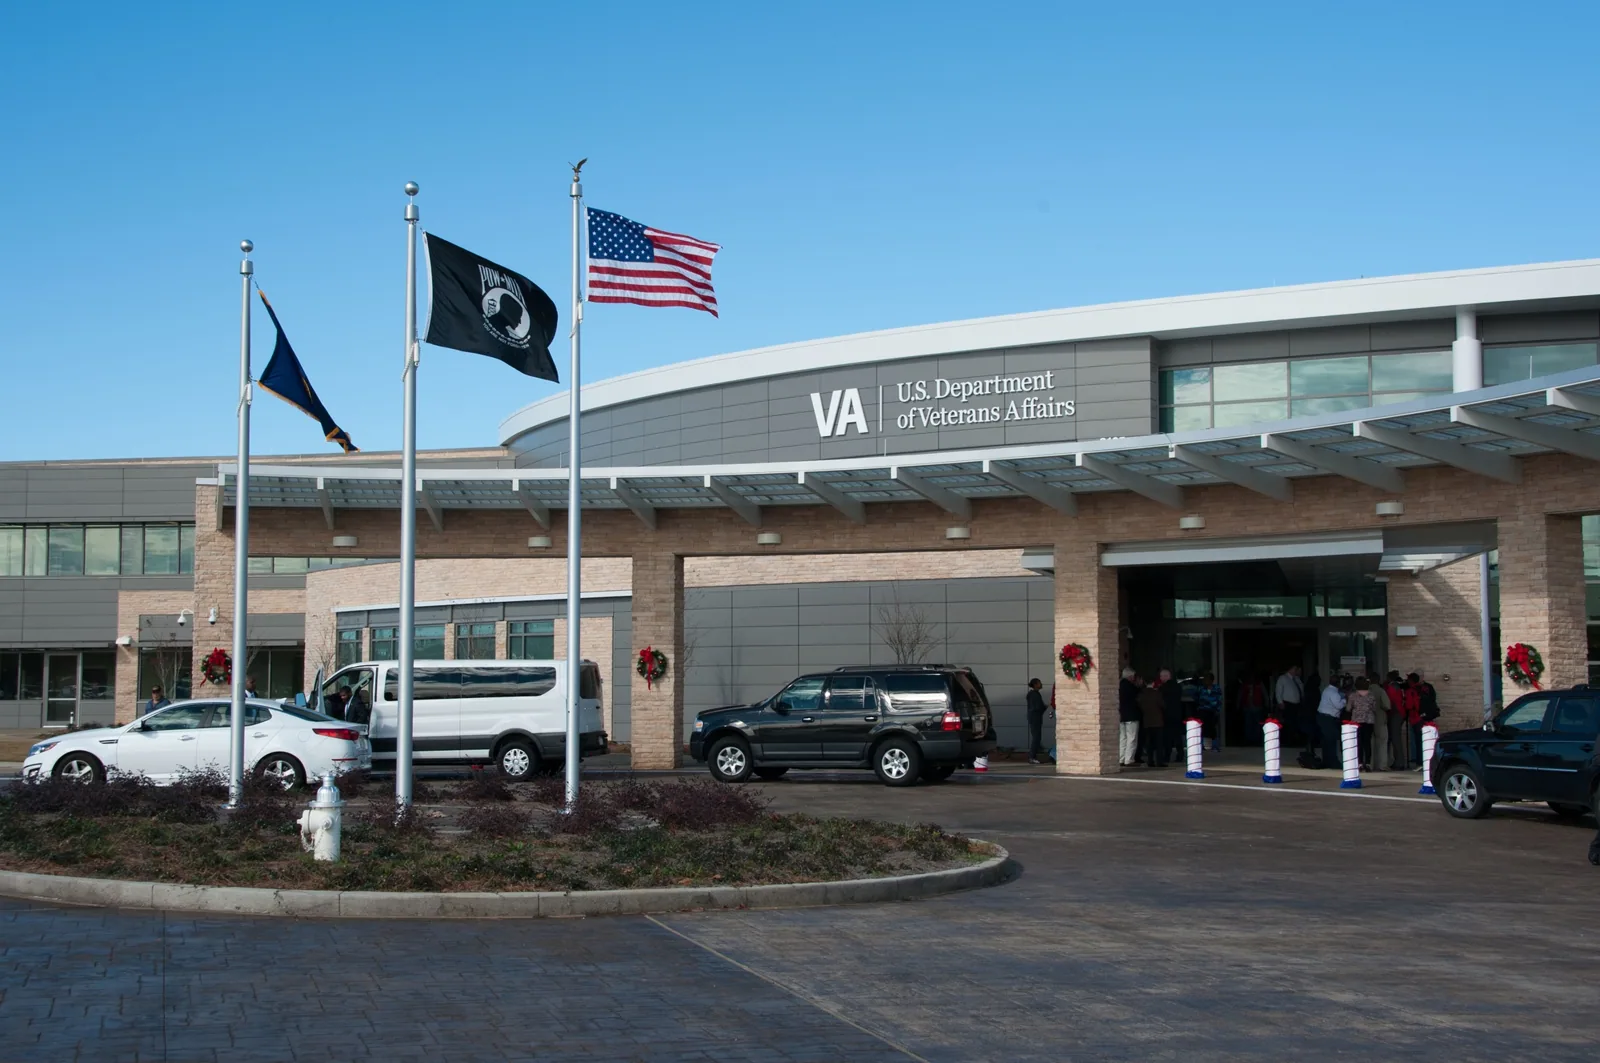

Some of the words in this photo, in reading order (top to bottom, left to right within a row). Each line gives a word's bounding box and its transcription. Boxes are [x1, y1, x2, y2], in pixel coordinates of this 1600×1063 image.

[897, 381, 931, 403] U.S.
[935, 370, 1055, 402] Department
[810, 388, 869, 437] VA
[897, 406, 917, 429] of
[917, 406, 1001, 427] Veterans
[1004, 396, 1076, 421] Affairs
